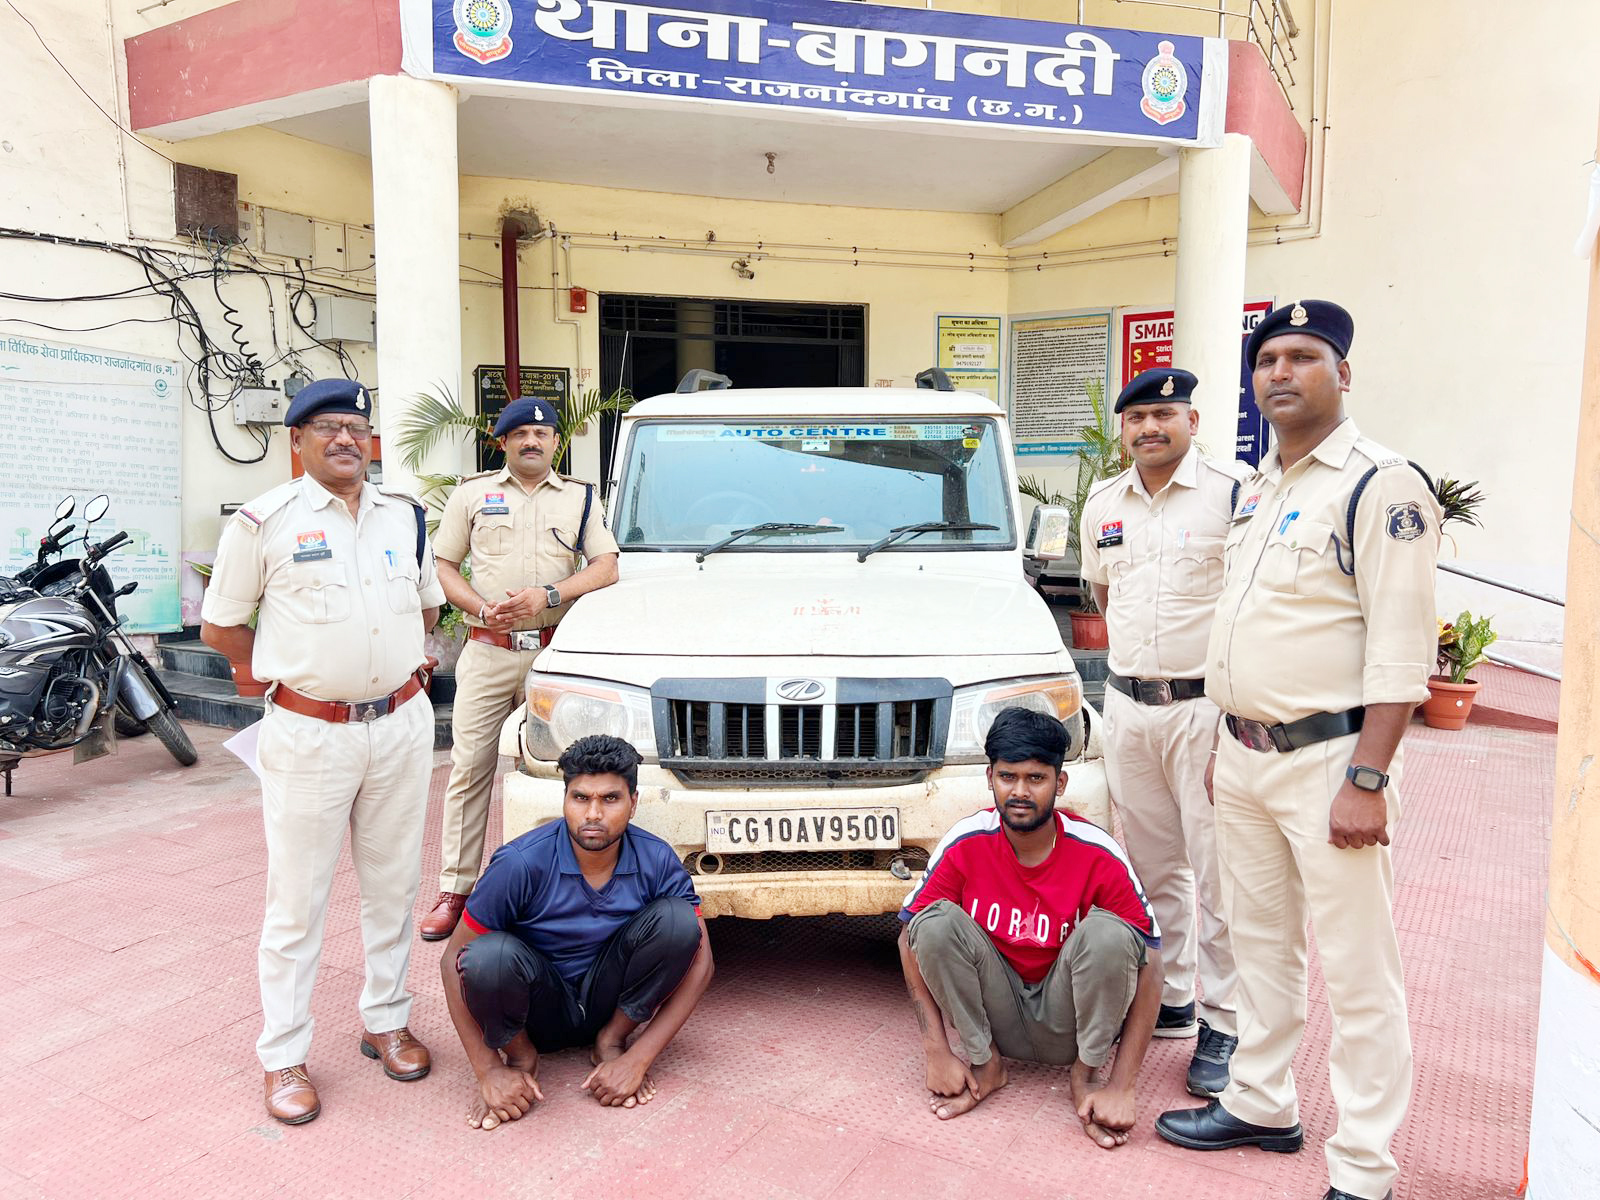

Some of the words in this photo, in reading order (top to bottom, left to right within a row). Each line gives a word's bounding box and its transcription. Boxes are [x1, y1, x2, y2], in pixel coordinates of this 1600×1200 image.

[533, 0, 1121, 97] थाना-बागनदी
[586, 57, 953, 112] जिला-राजनांदगांव
[967, 94, 1084, 126] (छ.ग.)
[8, 337, 39, 356] विधिक
[40, 343, 60, 360] सेवा
[60, 348, 103, 365] प्राधिकरण
[104, 356, 152, 374] राजनांदगांव
[1133, 348, 1142, 364] S
[720, 429, 784, 437] AUTO
[789, 428, 887, 437] CENTRE
[710, 827, 726, 836] IND
[728, 813, 896, 844] CG10AV9500
